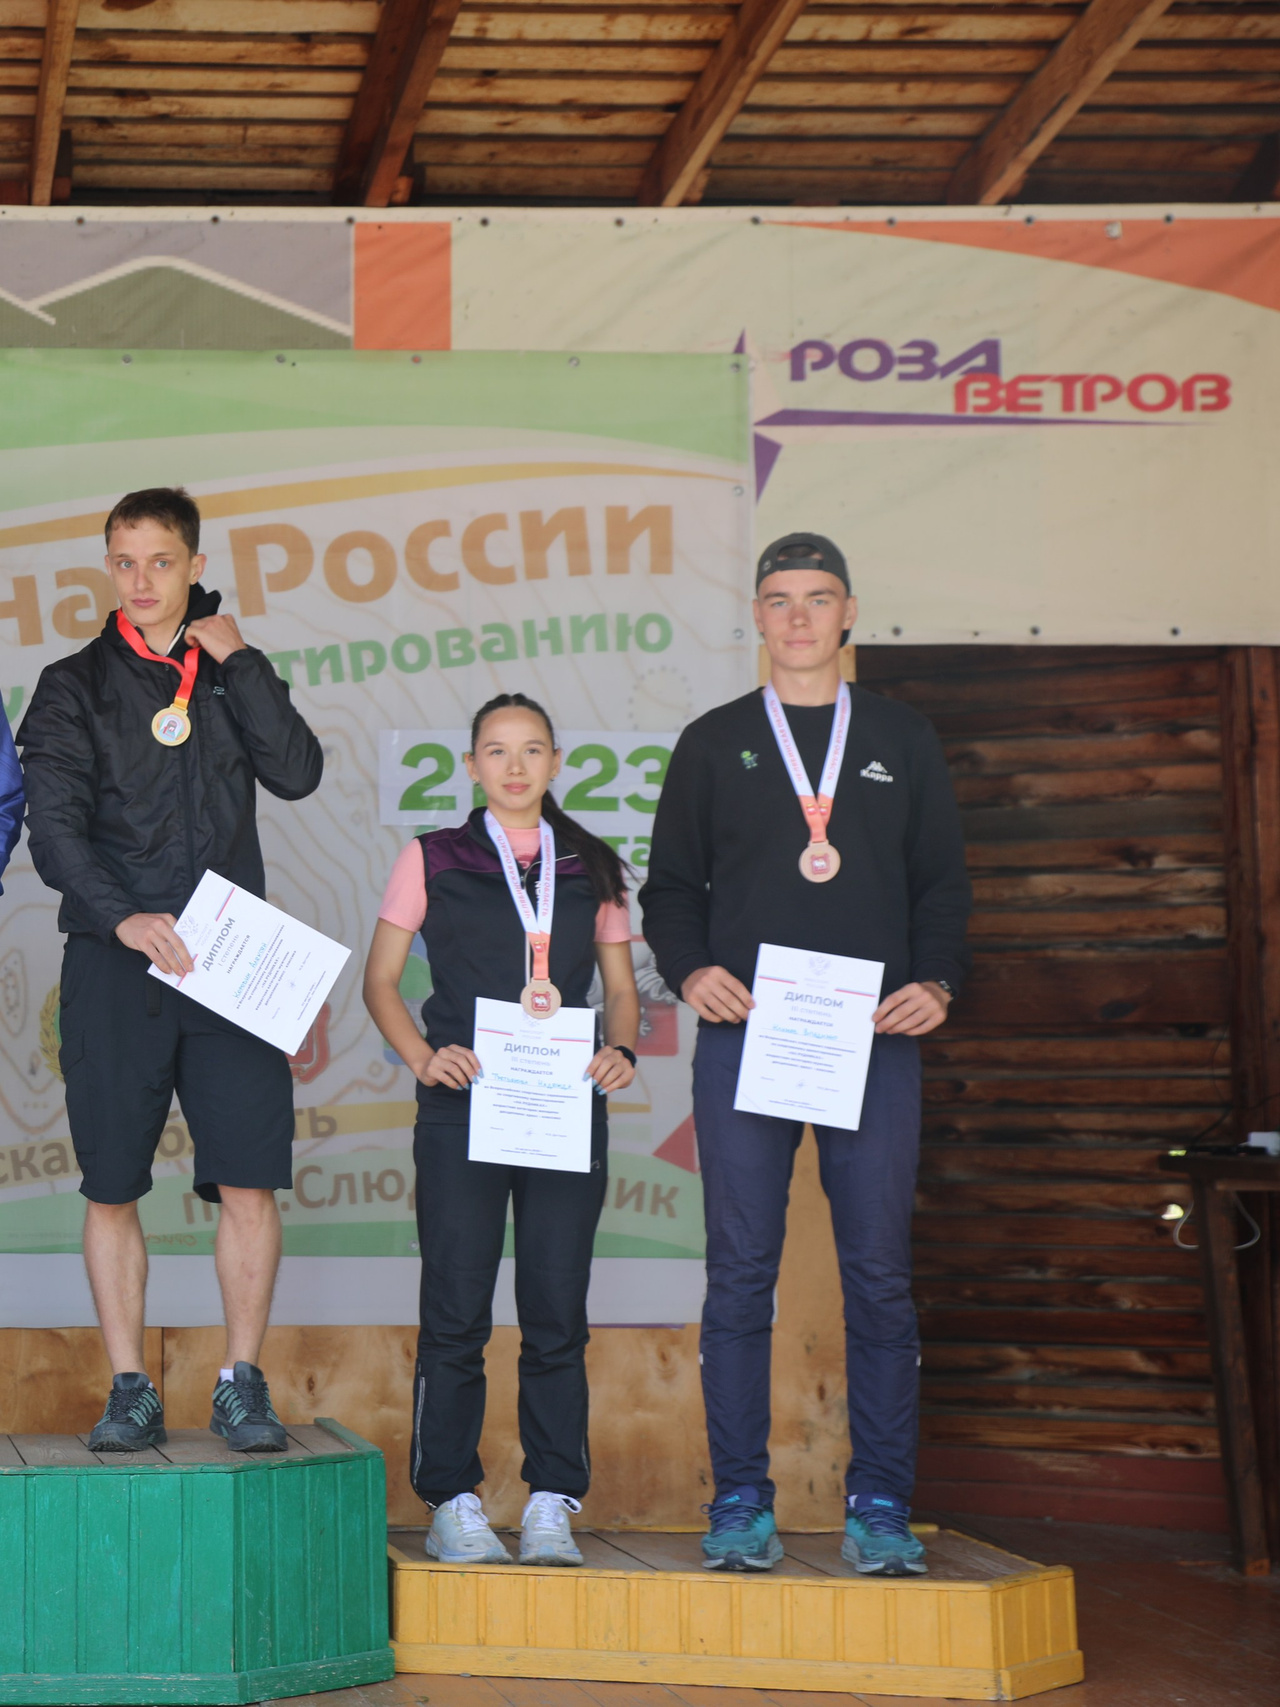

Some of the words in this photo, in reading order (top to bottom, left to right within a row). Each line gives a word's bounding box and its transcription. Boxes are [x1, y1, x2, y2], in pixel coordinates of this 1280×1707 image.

[790, 338, 1001, 382] РОЗА
[954, 373, 1232, 413] ВЕТРОВ
[228, 504, 674, 617] России
[272, 611, 673, 688] тированию
[398, 742, 672, 814] 223
[860, 768, 894, 783] Kappa
[200, 916, 237, 971] ДИПЛОМ
[219, 933, 240, 963] степень
[226, 934, 251, 974] НАГРАЖДАЕТСЯ
[784, 991, 843, 1008] ДИПЛОМ
[504, 1043, 560, 1056] ДИПЛОМ
